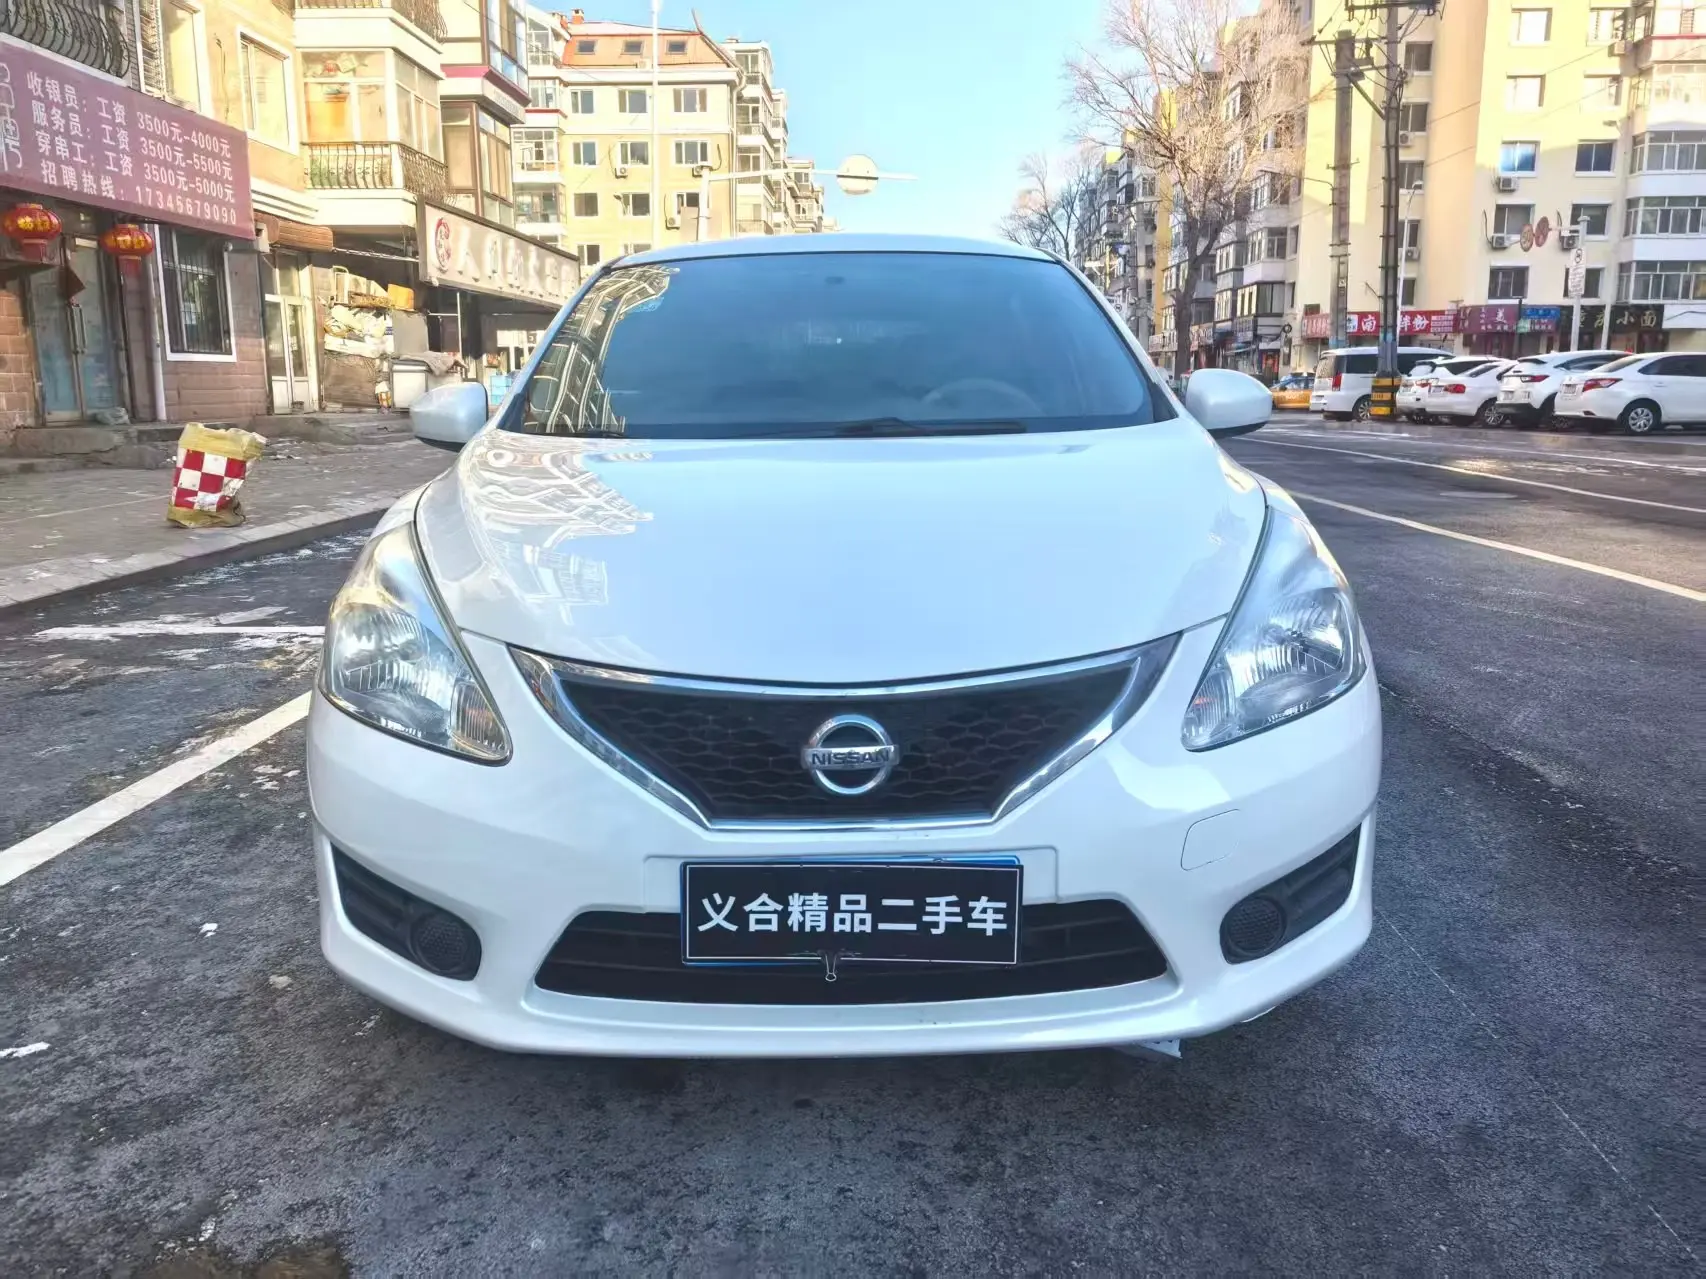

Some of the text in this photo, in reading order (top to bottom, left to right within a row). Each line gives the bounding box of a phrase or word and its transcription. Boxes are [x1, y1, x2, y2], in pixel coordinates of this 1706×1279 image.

[97, 96, 127, 126] 工资
[137, 111, 231, 158] 3500元-4000元
[101, 124, 130, 152] 工资
[140, 137, 233, 180] 3500元-5500元
[104, 150, 133, 177] 工资
[143, 162, 235, 203] 3500元-5000元
[136, 185, 236, 225] 17345679090
[812, 749, 889, 766] NISSAN
[697, 893, 1008, 937] 义合精品二手车
